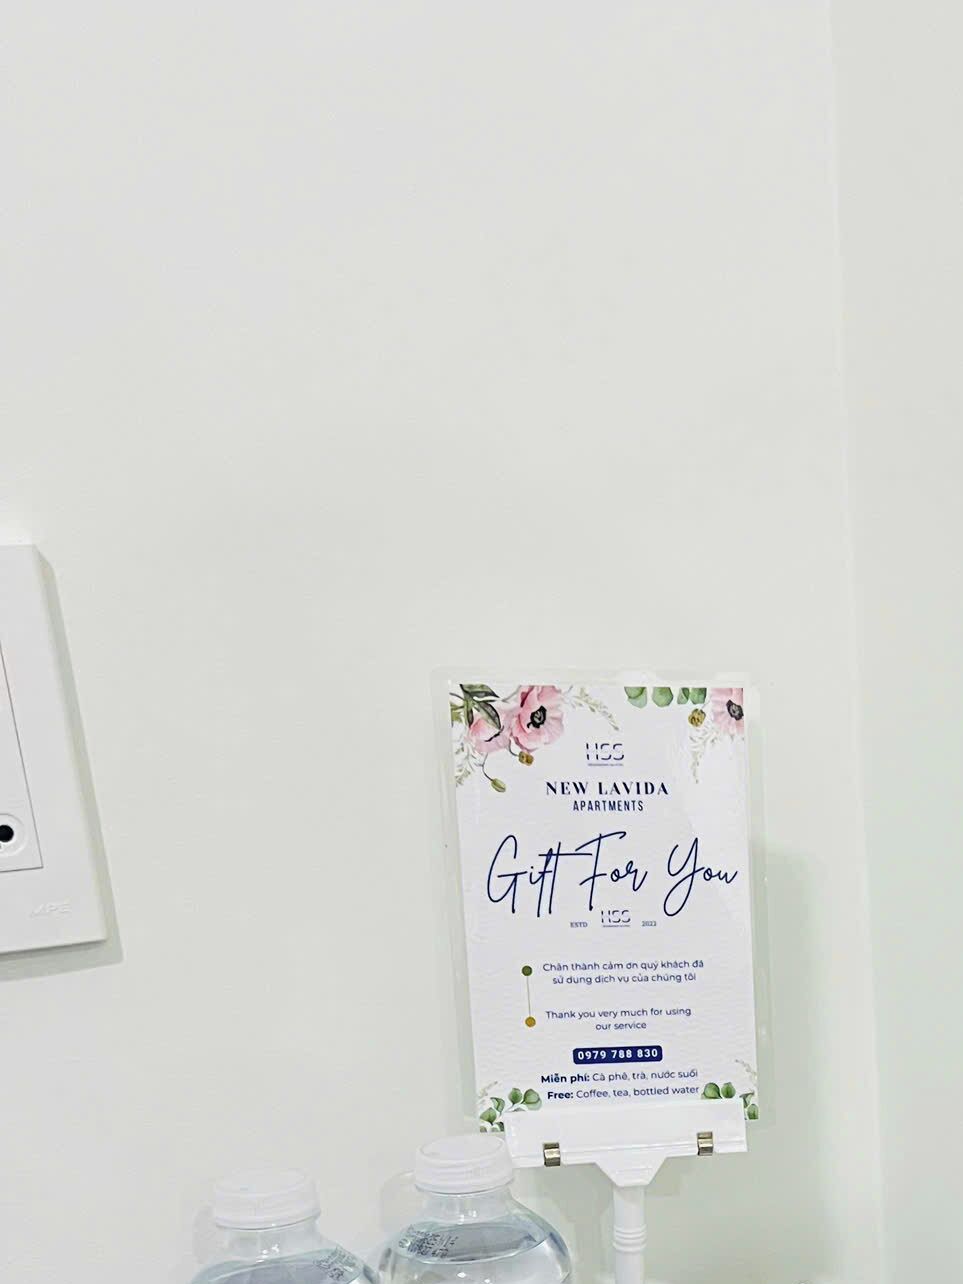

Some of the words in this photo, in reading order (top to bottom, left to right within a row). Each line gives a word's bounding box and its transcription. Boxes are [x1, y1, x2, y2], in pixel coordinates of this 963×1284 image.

[545, 781, 588, 796] NEW
[598, 781, 669, 796] LAVIDA
[572, 799, 644, 812] APARTMENTS
[487, 834, 592, 918] Gift
[575, 831, 648, 911] For
[663, 837, 739, 917] You
[542, 962, 569, 972] Chân
[571, 961, 600, 972] thành
[602, 960, 624, 970] cảm
[641, 960, 659, 972] quý
[660, 960, 690, 970] khách
[566, 975, 593, 986] dụng
[594, 974, 616, 985] dịch
[617, 975, 630, 985] vụ
[631, 973, 649, 983] của
[651, 973, 682, 984] chúng
[684, 972, 697, 982] tôi
[545, 1010, 576, 1020] Thank
[578, 1011, 596, 1021] you
[598, 1010, 618, 1020] very
[620, 1008, 649, 1018] much
[650, 1007, 663, 1017] for
[665, 1007, 692, 1018] using
[595, 1023, 612, 1031] our
[613, 1021, 647, 1031] service
[577, 1049, 607, 1061] 0979
[610, 1048, 633, 1060] 788
[636, 1047, 659, 1058] 830
[541, 1072, 567, 1084] Miễn
[570, 1073, 591, 1085] phí:
[592, 1071, 606, 1082] Cà
[608, 1071, 631, 1083] phê,
[632, 1070, 648, 1081] trà,
[650, 1070, 676, 1080] nước
[678, 1068, 698, 1079] suối
[547, 1091, 574, 1100] Free:
[576, 1089, 611, 1099] Coffee,
[613, 1088, 632, 1098] tea,
[633, 1086, 670, 1096] bottled
[671, 1086, 700, 1096] water
